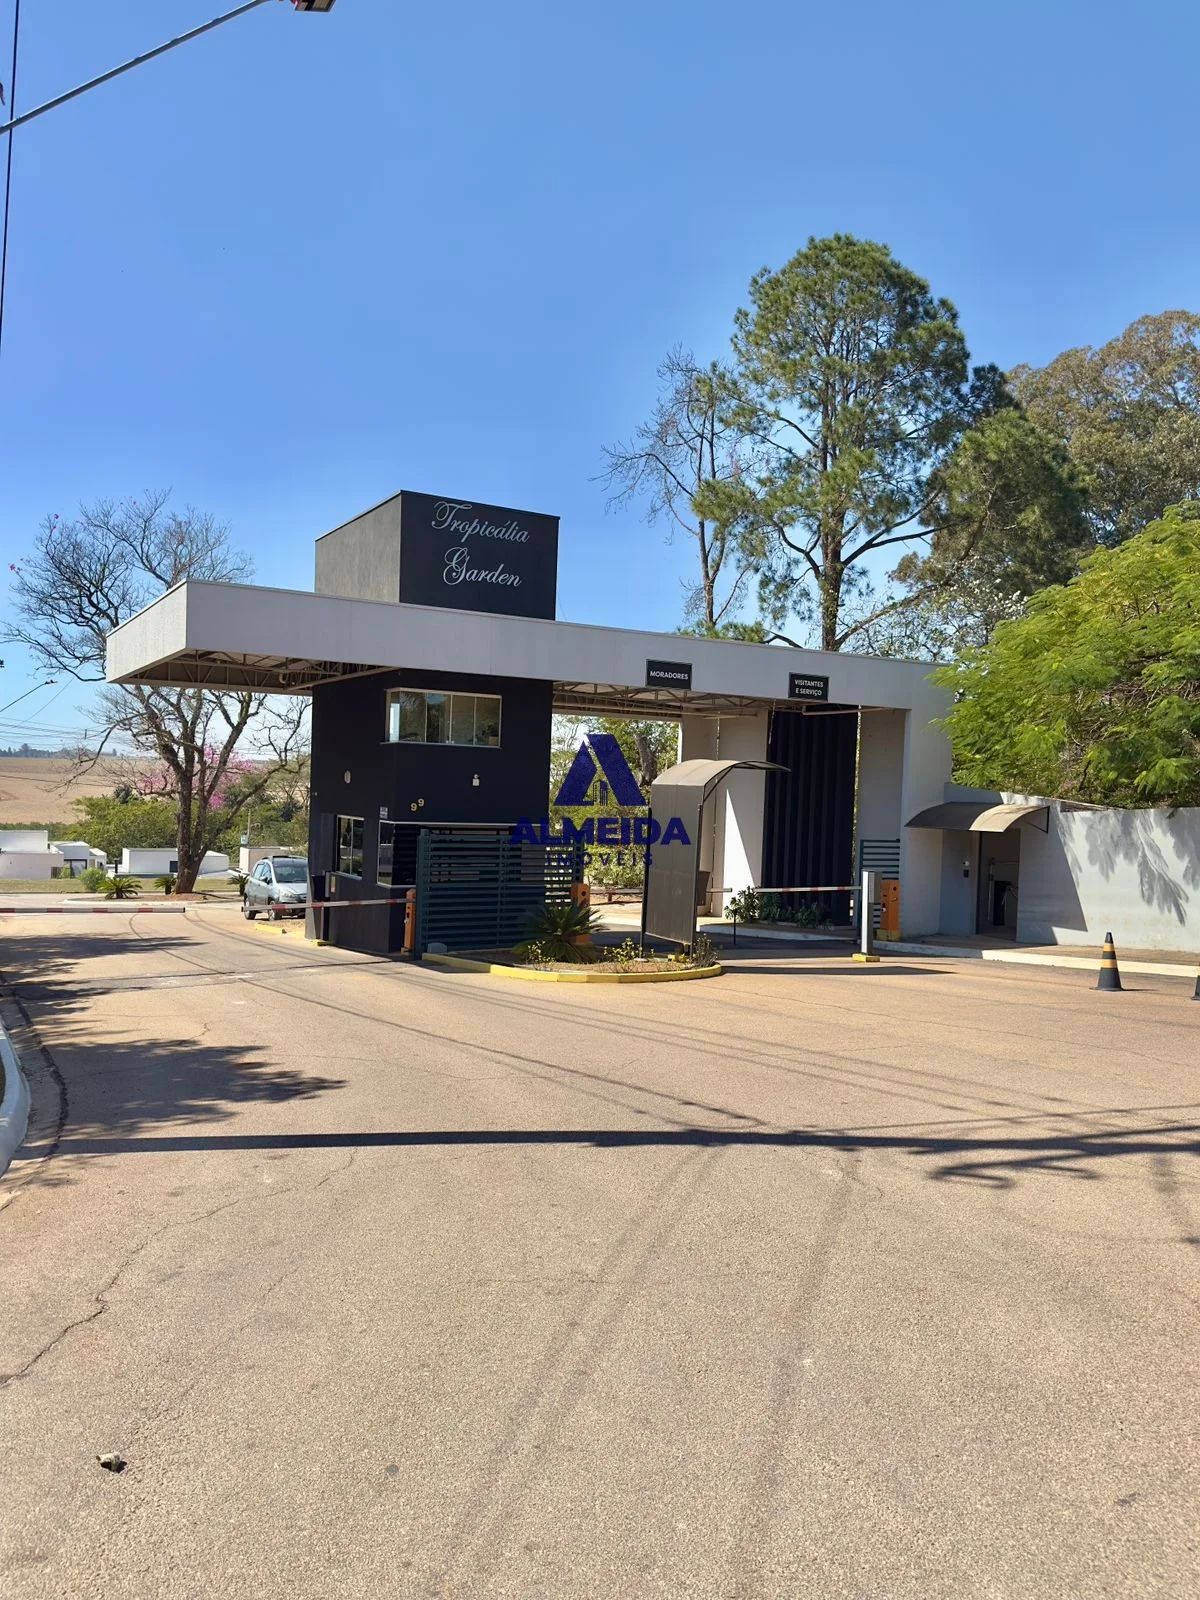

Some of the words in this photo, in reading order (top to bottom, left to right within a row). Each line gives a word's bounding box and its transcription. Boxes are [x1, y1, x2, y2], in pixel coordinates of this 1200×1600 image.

[431, 501, 530, 542] Tropicália
[443, 546, 522, 587] Garden
[650, 670, 689, 680] MORADORES
[794, 679, 824, 688] VISITANTES
[800, 688, 822, 697] SERVIÇO
